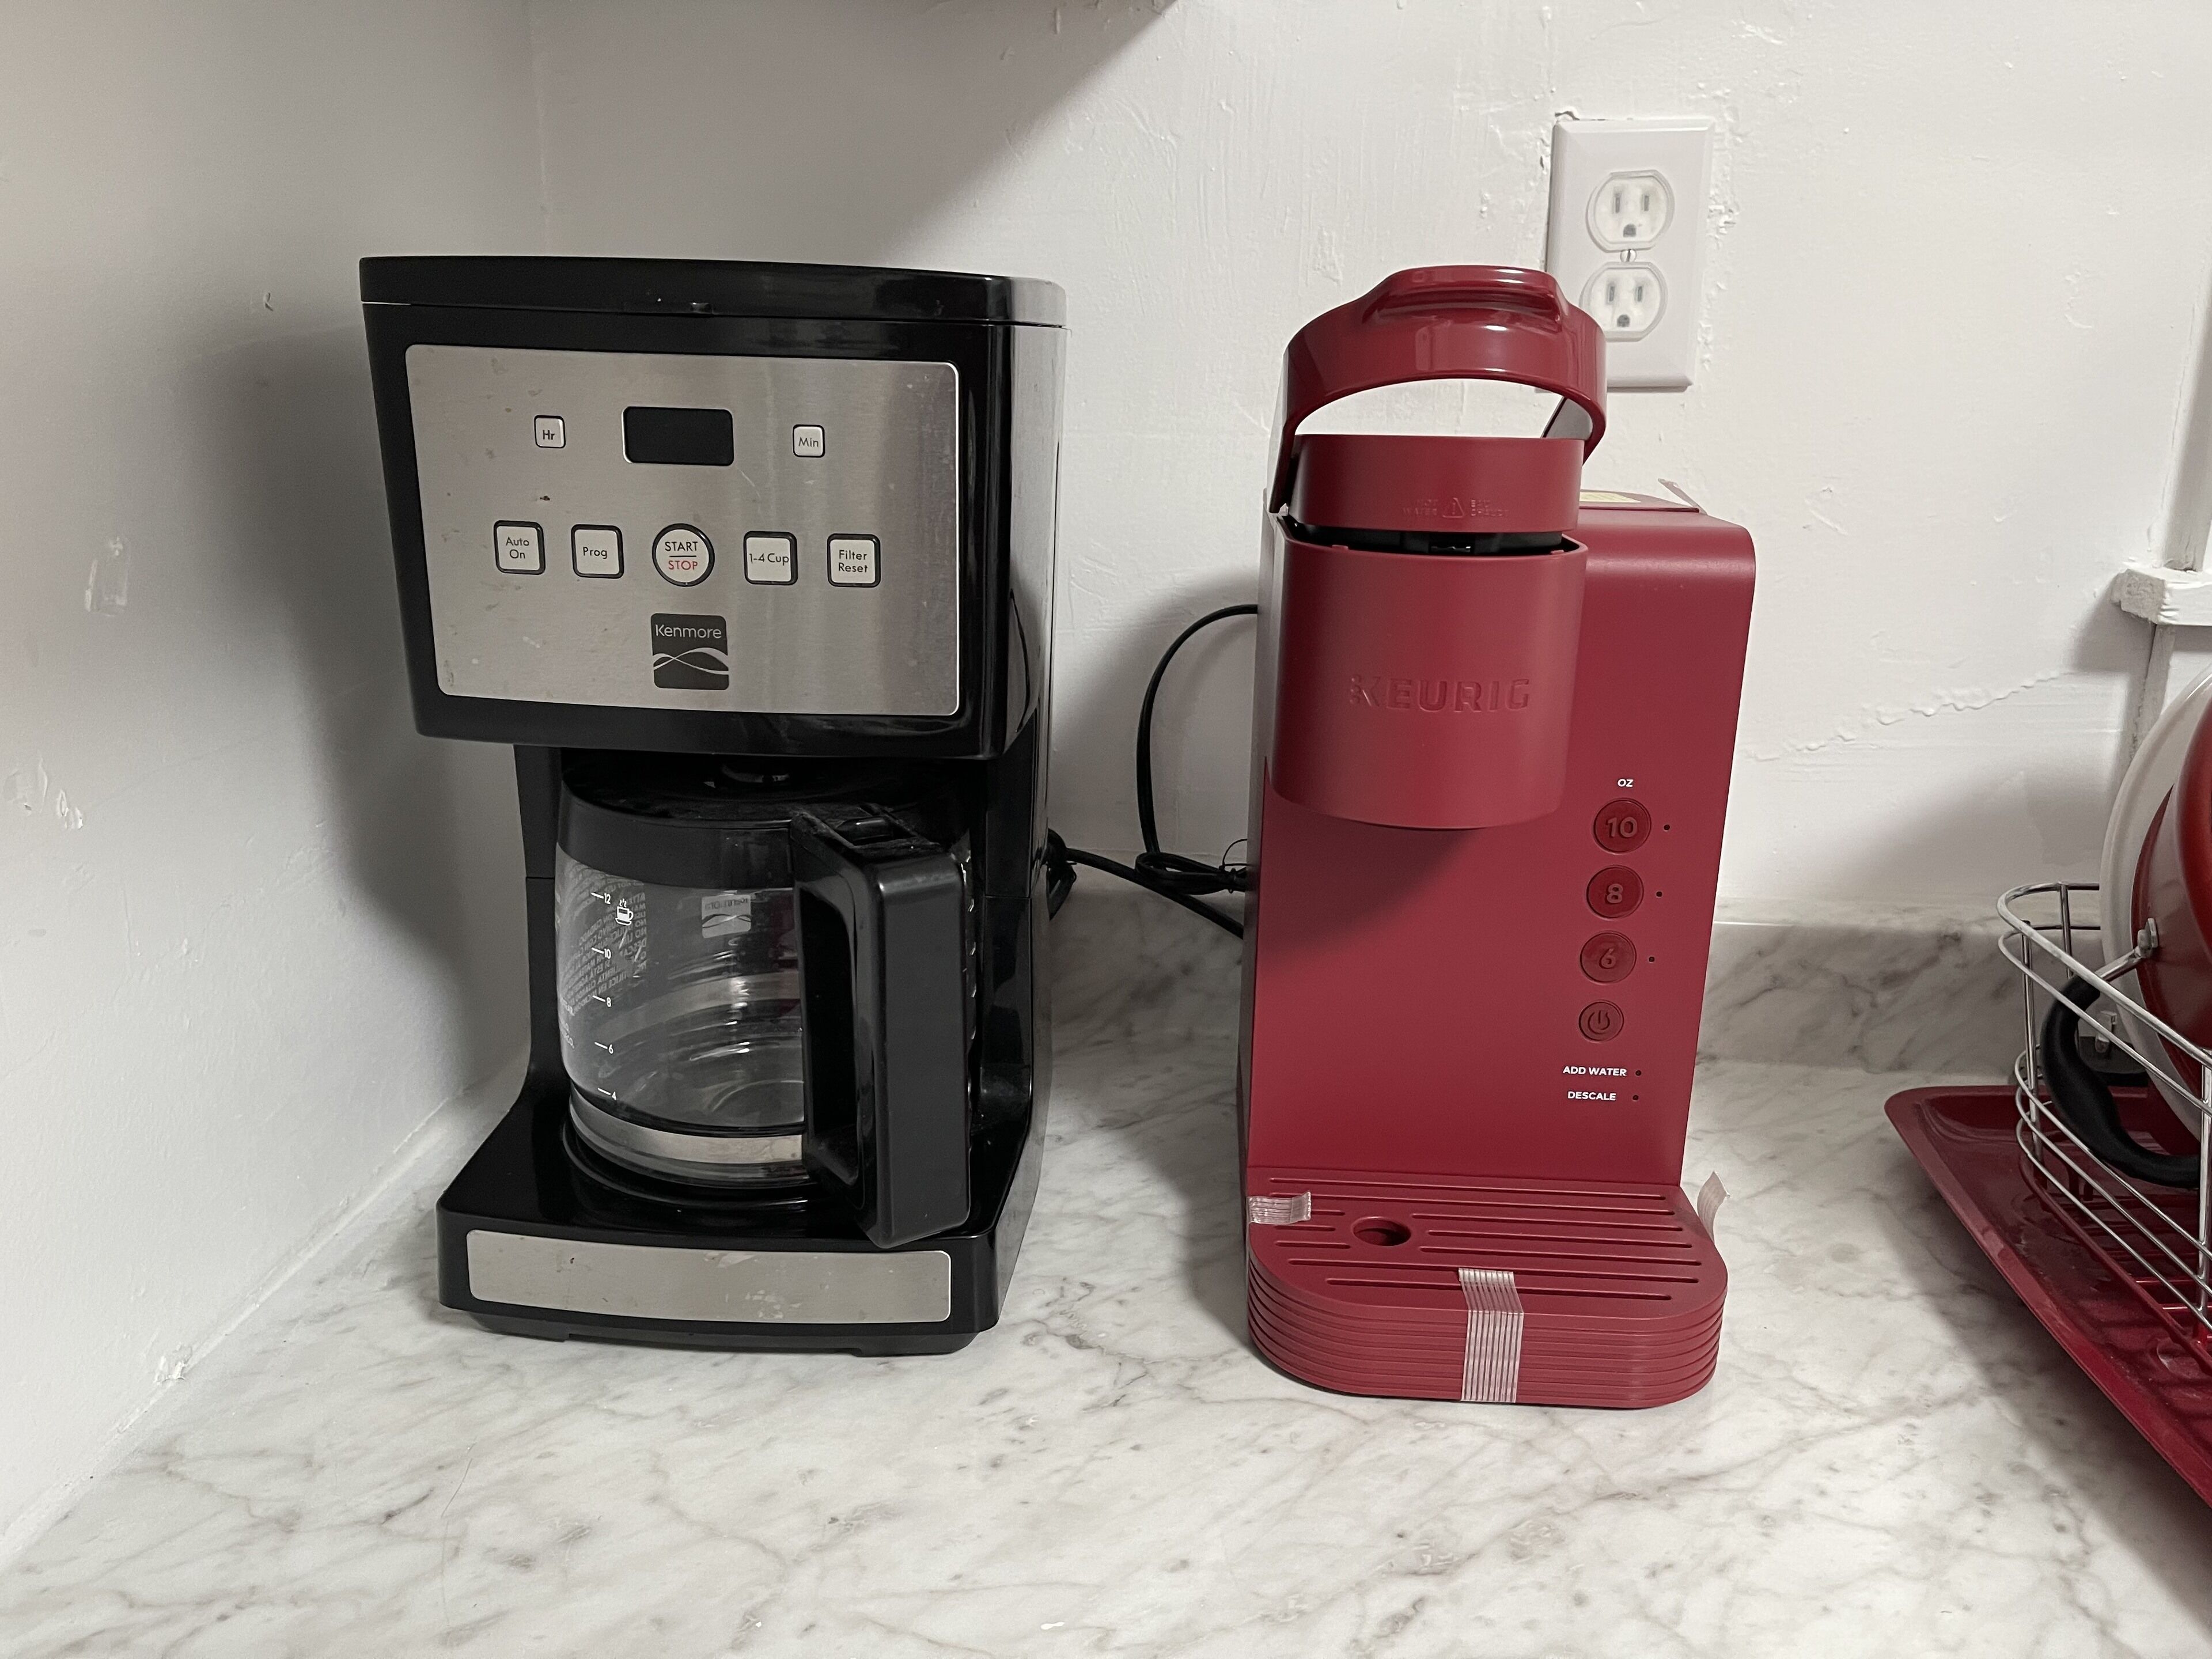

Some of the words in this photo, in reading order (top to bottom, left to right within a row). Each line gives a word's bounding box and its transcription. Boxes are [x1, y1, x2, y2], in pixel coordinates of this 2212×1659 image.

[543, 429, 555, 440] Hr
[798, 436, 819, 448] Min
[505, 536, 529, 547] Auto
[665, 541, 698, 552] START
[509, 549, 526, 559] On
[583, 546, 608, 560] Prog
[839, 549, 868, 560] Filter
[749, 553, 765, 563] 1-4
[767, 552, 789, 566] Cup
[668, 560, 698, 571] STOP
[838, 562, 868, 573] Reset
[655, 624, 722, 639] Kenmore
[1350, 674, 1530, 712] KEURIG
[1618, 778, 1634, 787] OZ
[1606, 816, 1638, 838] 10
[604, 892, 612, 904] 12
[1606, 884, 1623, 904] 8
[604, 948, 612, 959] 10
[1599, 948, 1616, 969] 6
[606, 997, 612, 1007] 8
[608, 1044, 614, 1054] 6
[1562, 1066, 1586, 1075] ADD
[1588, 1066, 1627, 1077] WATER
[612, 1091, 616, 1100] 4
[1567, 1090, 1617, 1101] DESCALE
